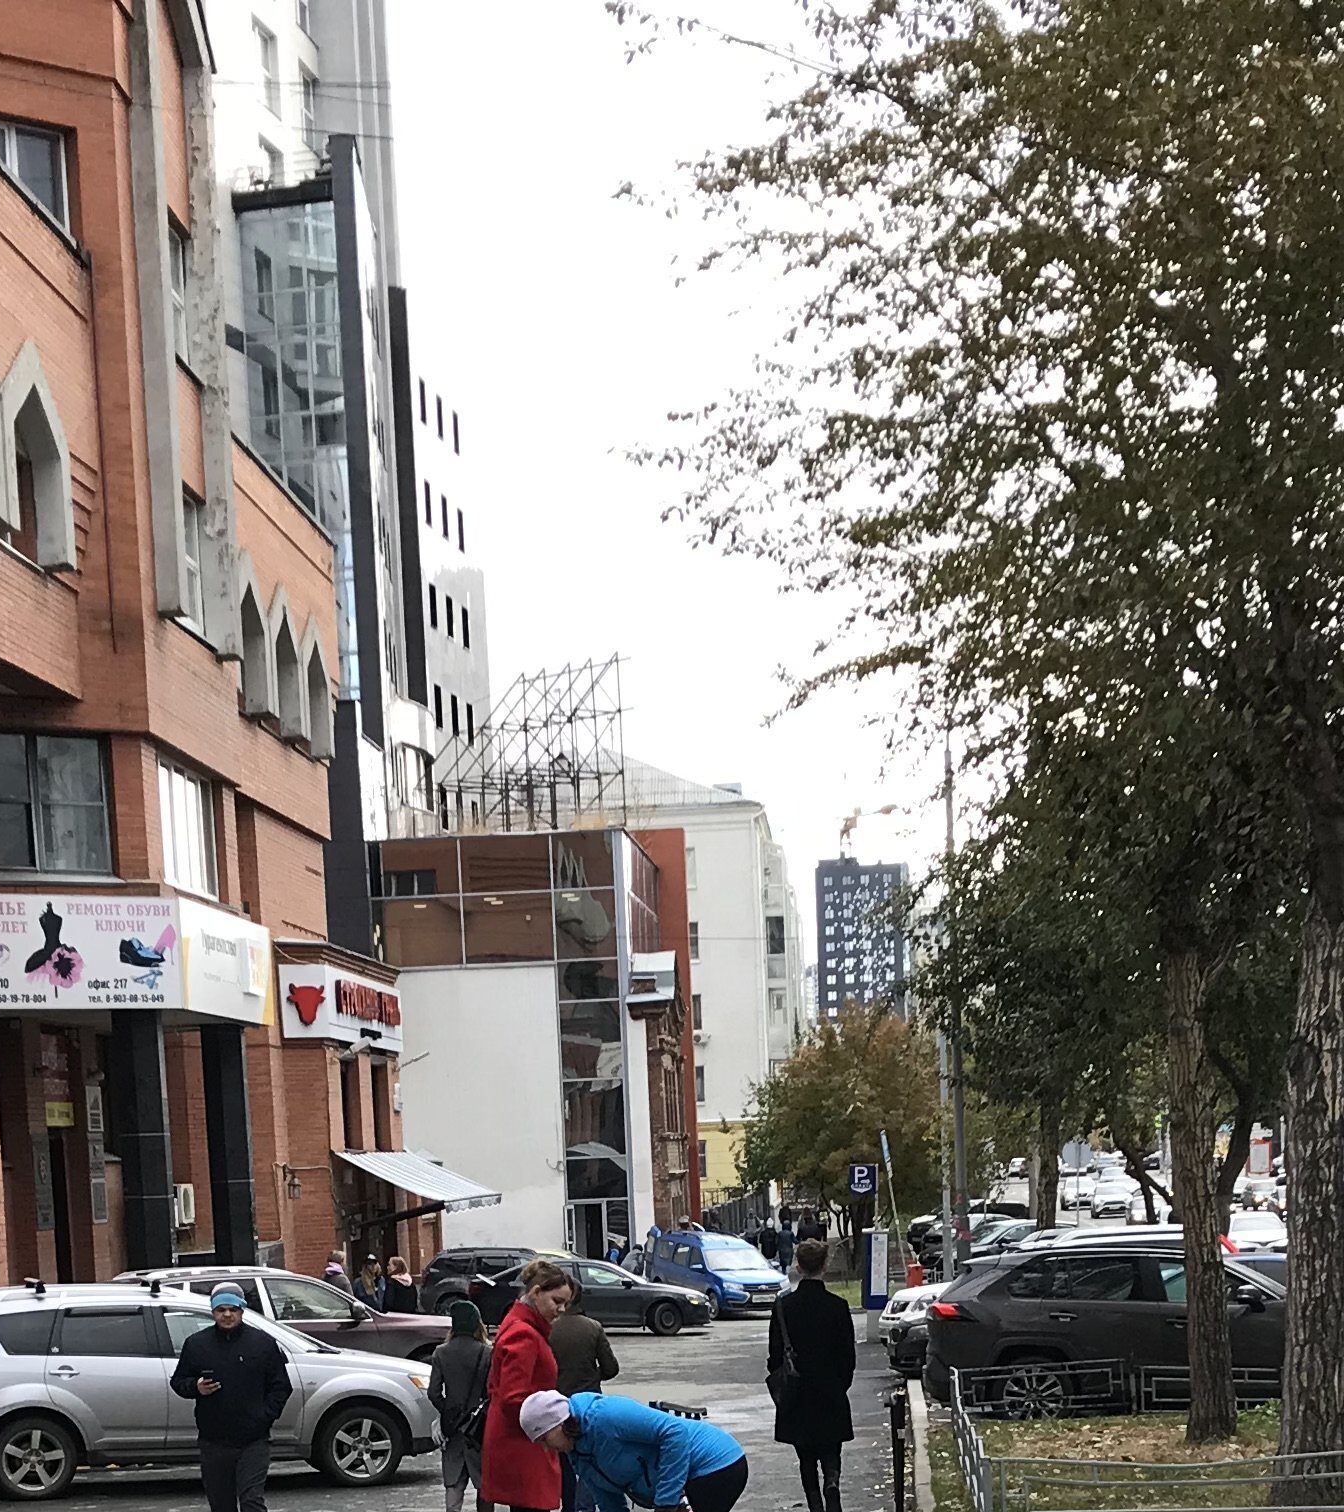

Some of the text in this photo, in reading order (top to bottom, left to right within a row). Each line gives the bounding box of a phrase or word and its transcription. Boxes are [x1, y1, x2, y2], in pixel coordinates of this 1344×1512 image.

[67, 903, 121, 916] РЕМОНТ
[127, 904, 171, 916] ОБУВИ
[96, 920, 146, 932] КЛЮЧИ
[88, 979, 128, 990] офис 217
[855, 1166, 868, 1183] P
